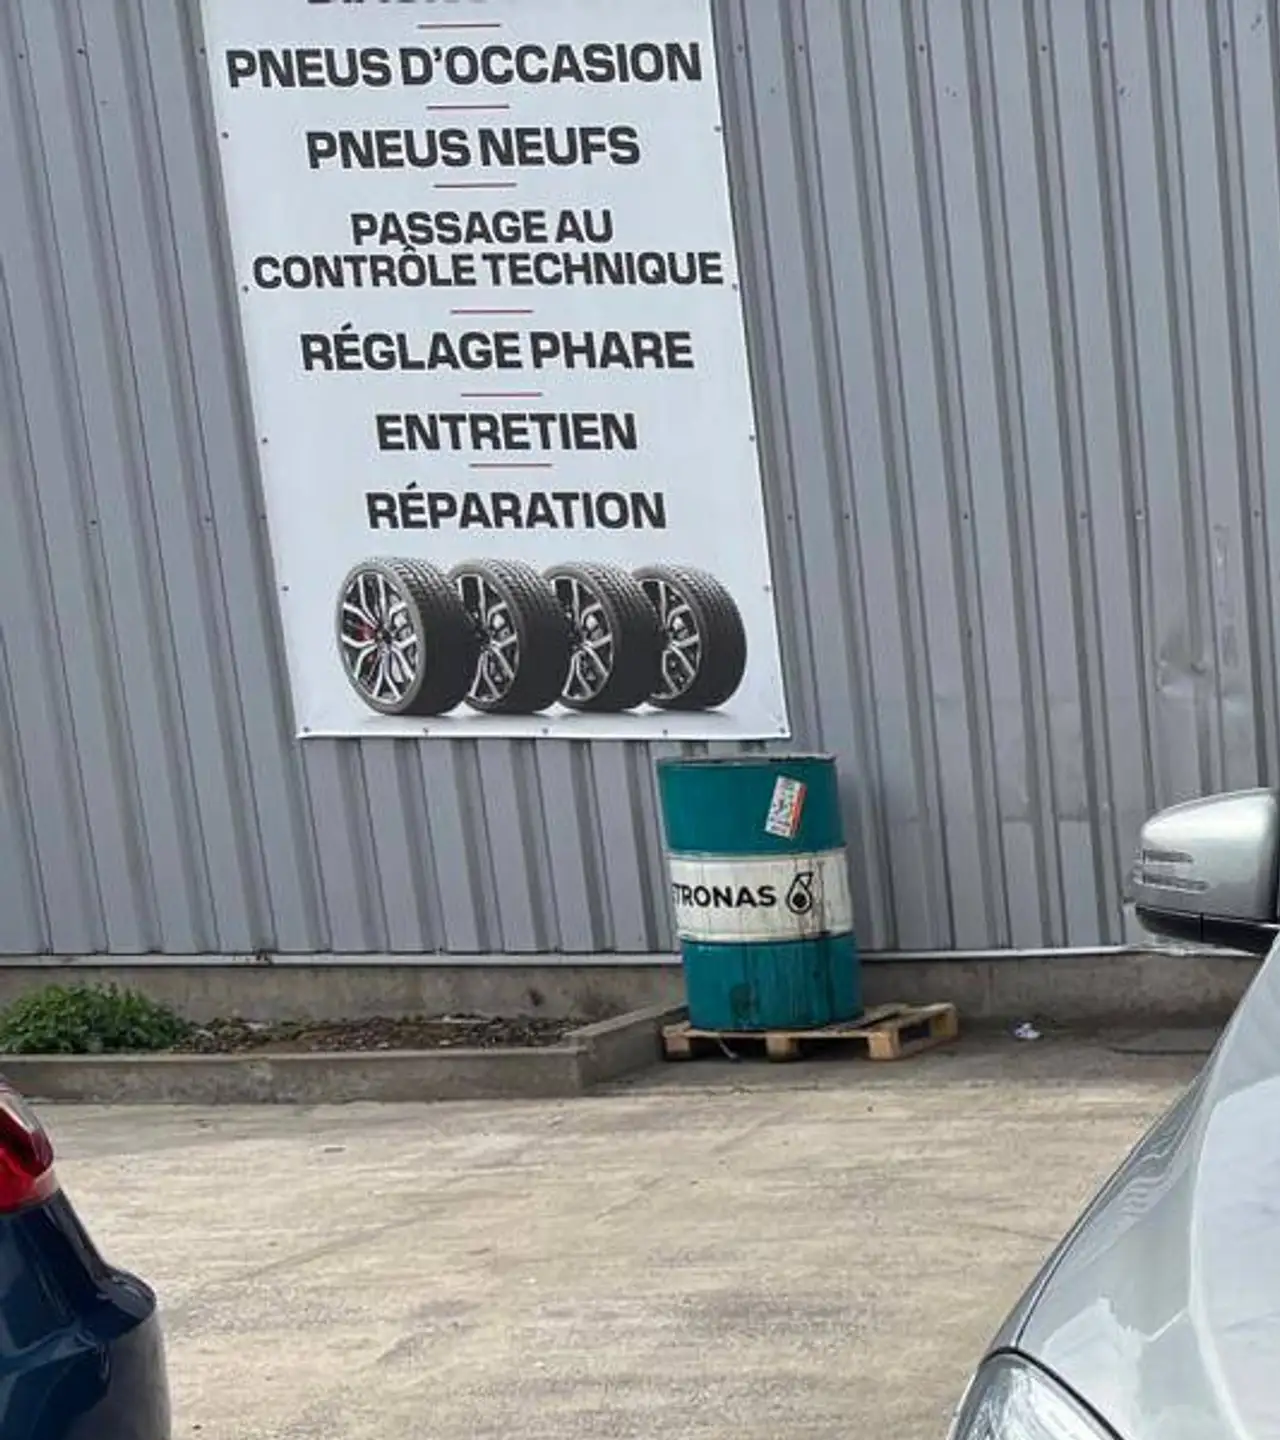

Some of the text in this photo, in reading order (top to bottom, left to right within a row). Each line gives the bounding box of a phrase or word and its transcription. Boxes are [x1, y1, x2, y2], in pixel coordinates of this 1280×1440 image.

[226, 42, 703, 88] PNEUS D'OCCASION
[306, 126, 641, 169] PNEUS NEUFS
[350, 209, 614, 246] PASSAGE AU
[253, 245, 725, 289] CONTRÔLE TECHNIQUE
[300, 322, 694, 371] RÉGLAGE PHARE
[375, 413, 638, 451] ENTRETIEN
[365, 482, 667, 530] RÉPARATION
